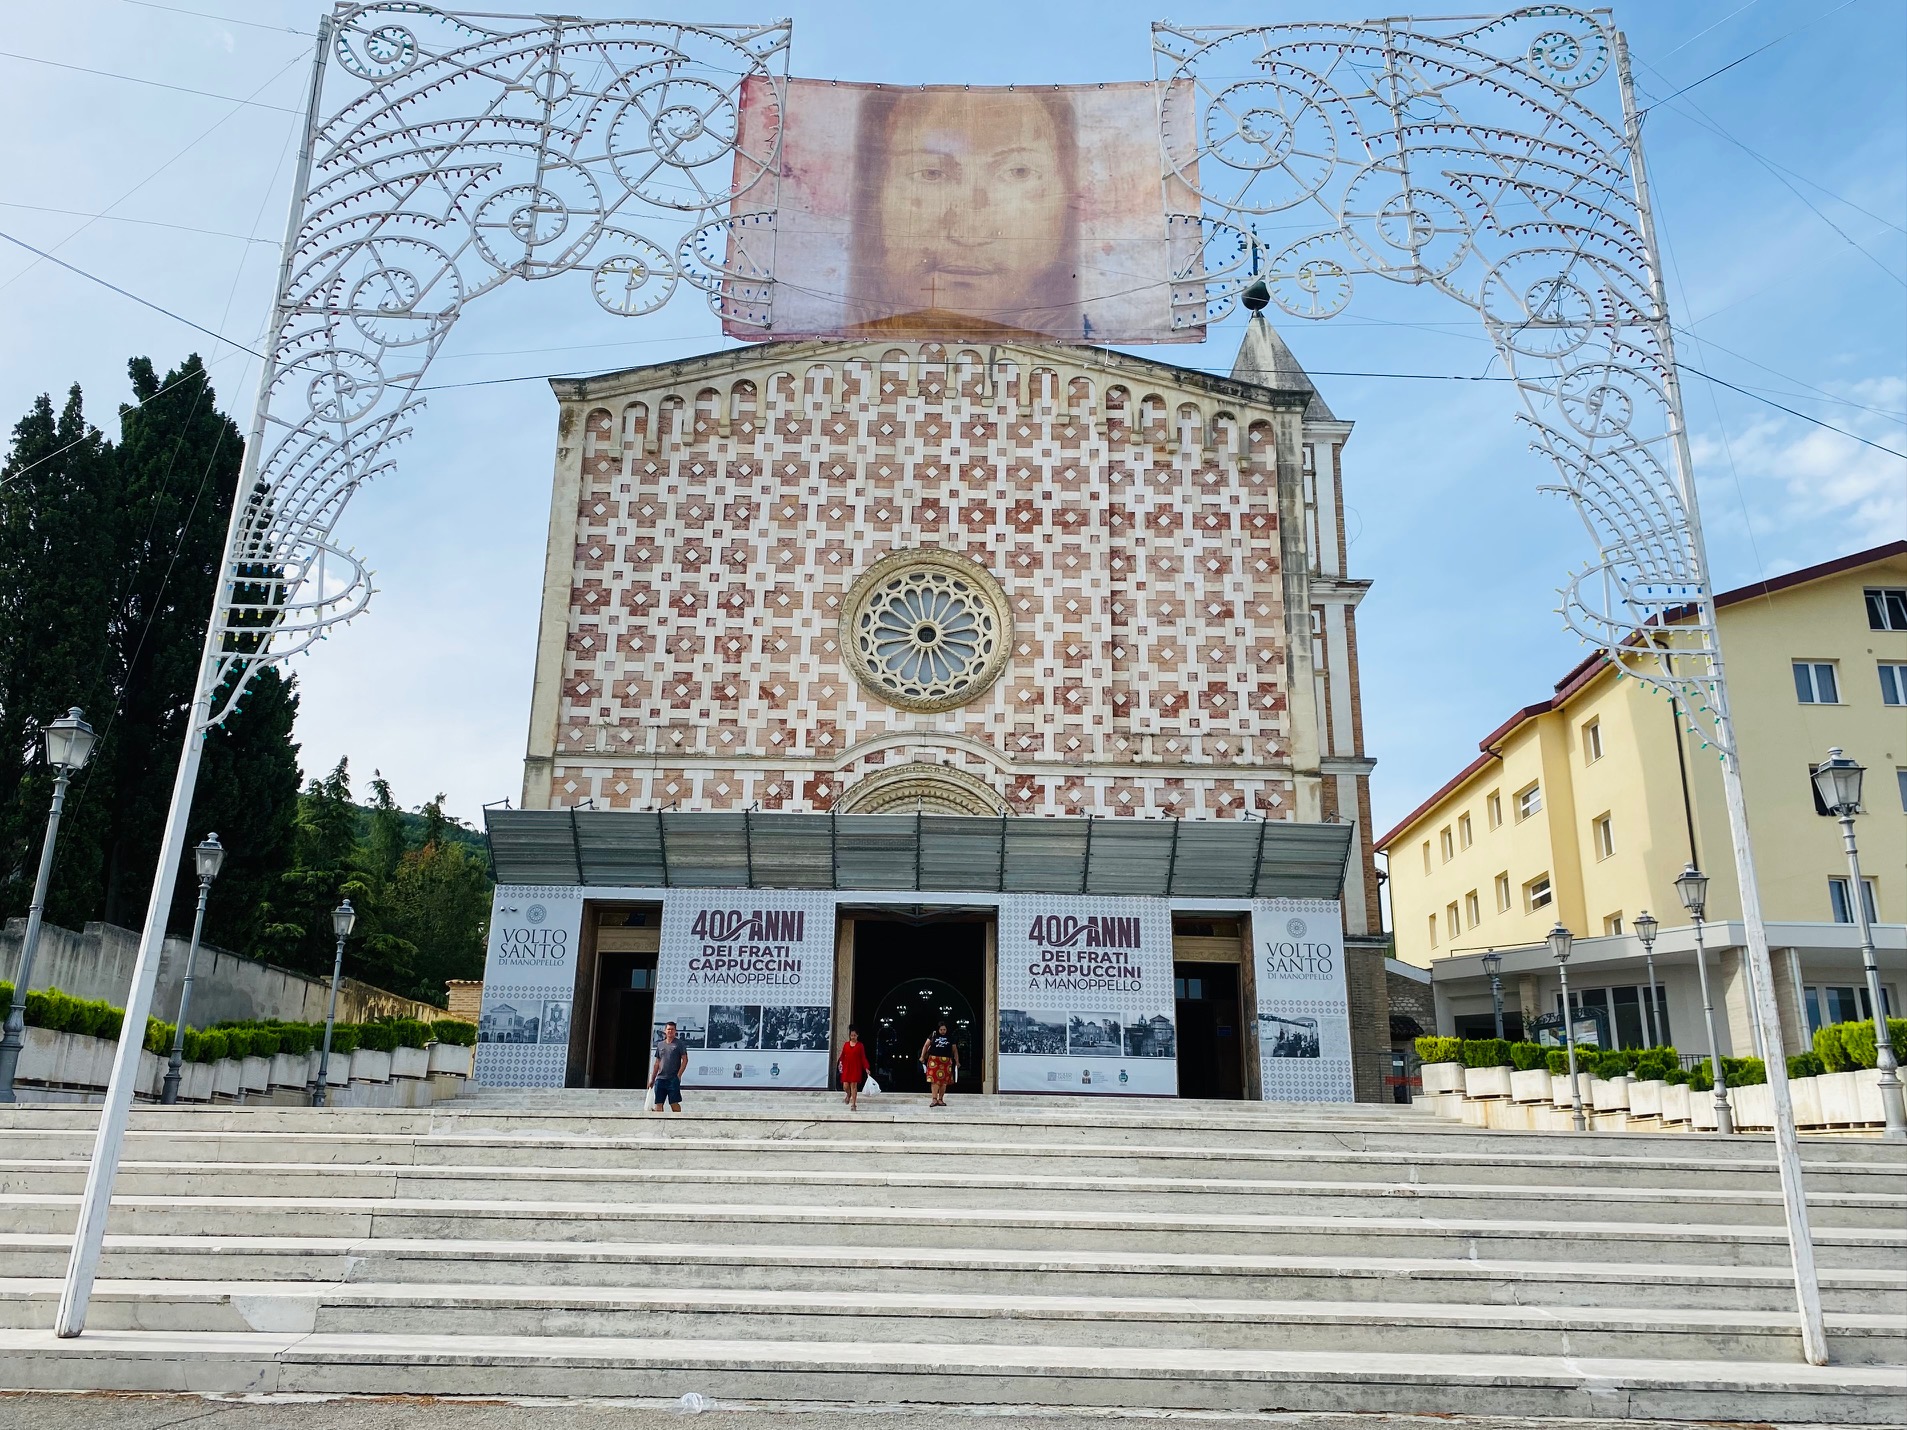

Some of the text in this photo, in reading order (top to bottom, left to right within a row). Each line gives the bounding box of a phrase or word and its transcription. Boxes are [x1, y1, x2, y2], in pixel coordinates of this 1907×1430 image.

[691, 910, 805, 942] 400 ANNI
[1029, 915, 1141, 948] 400 ANNI
[503, 928, 567, 944] VOLTO
[499, 943, 566, 959] SANTO
[702, 945, 790, 958] DEI FRATI
[1041, 950, 1129, 964] DEI FRATI
[1266, 942, 1332, 959] VOLTO
[510, 959, 565, 967] MANOPPELLO
[688, 958, 802, 972] CAPPUCCINI
[1266, 957, 1333, 974] SANTO
[688, 972, 801, 985] A MANOPPELLO
[1028, 963, 1142, 979] CAPPUCCINI
[1267, 972, 1333, 981] DI MANOPPELLO
[1029, 978, 1142, 992] A MANOPPELLO
